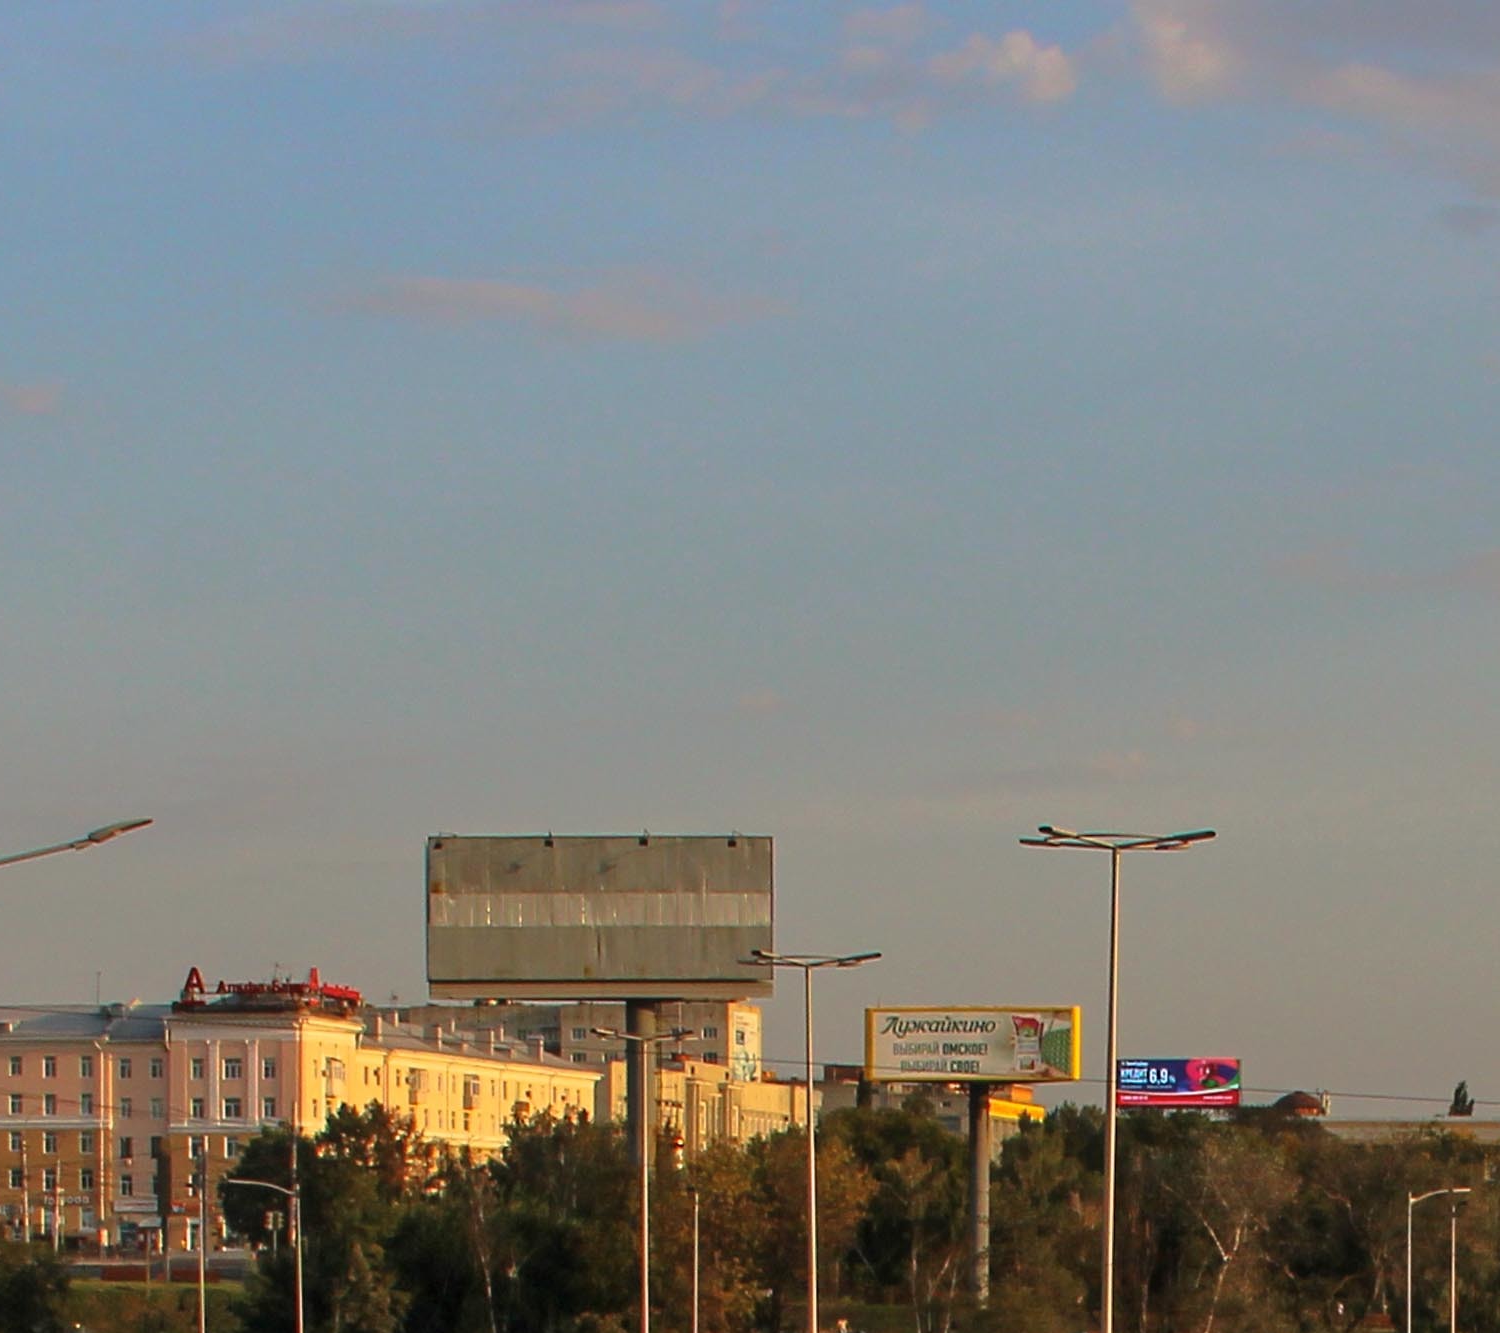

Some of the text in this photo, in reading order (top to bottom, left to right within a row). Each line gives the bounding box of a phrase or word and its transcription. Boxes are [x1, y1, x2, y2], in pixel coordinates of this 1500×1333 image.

[880, 1015, 996, 1038] Лужайкино
[893, 1042, 988, 1056] ВЫБИРАЙ ОМСКОЕ!
[901, 1060, 980, 1073] ВЫБИРАЙ СВОЕ!
